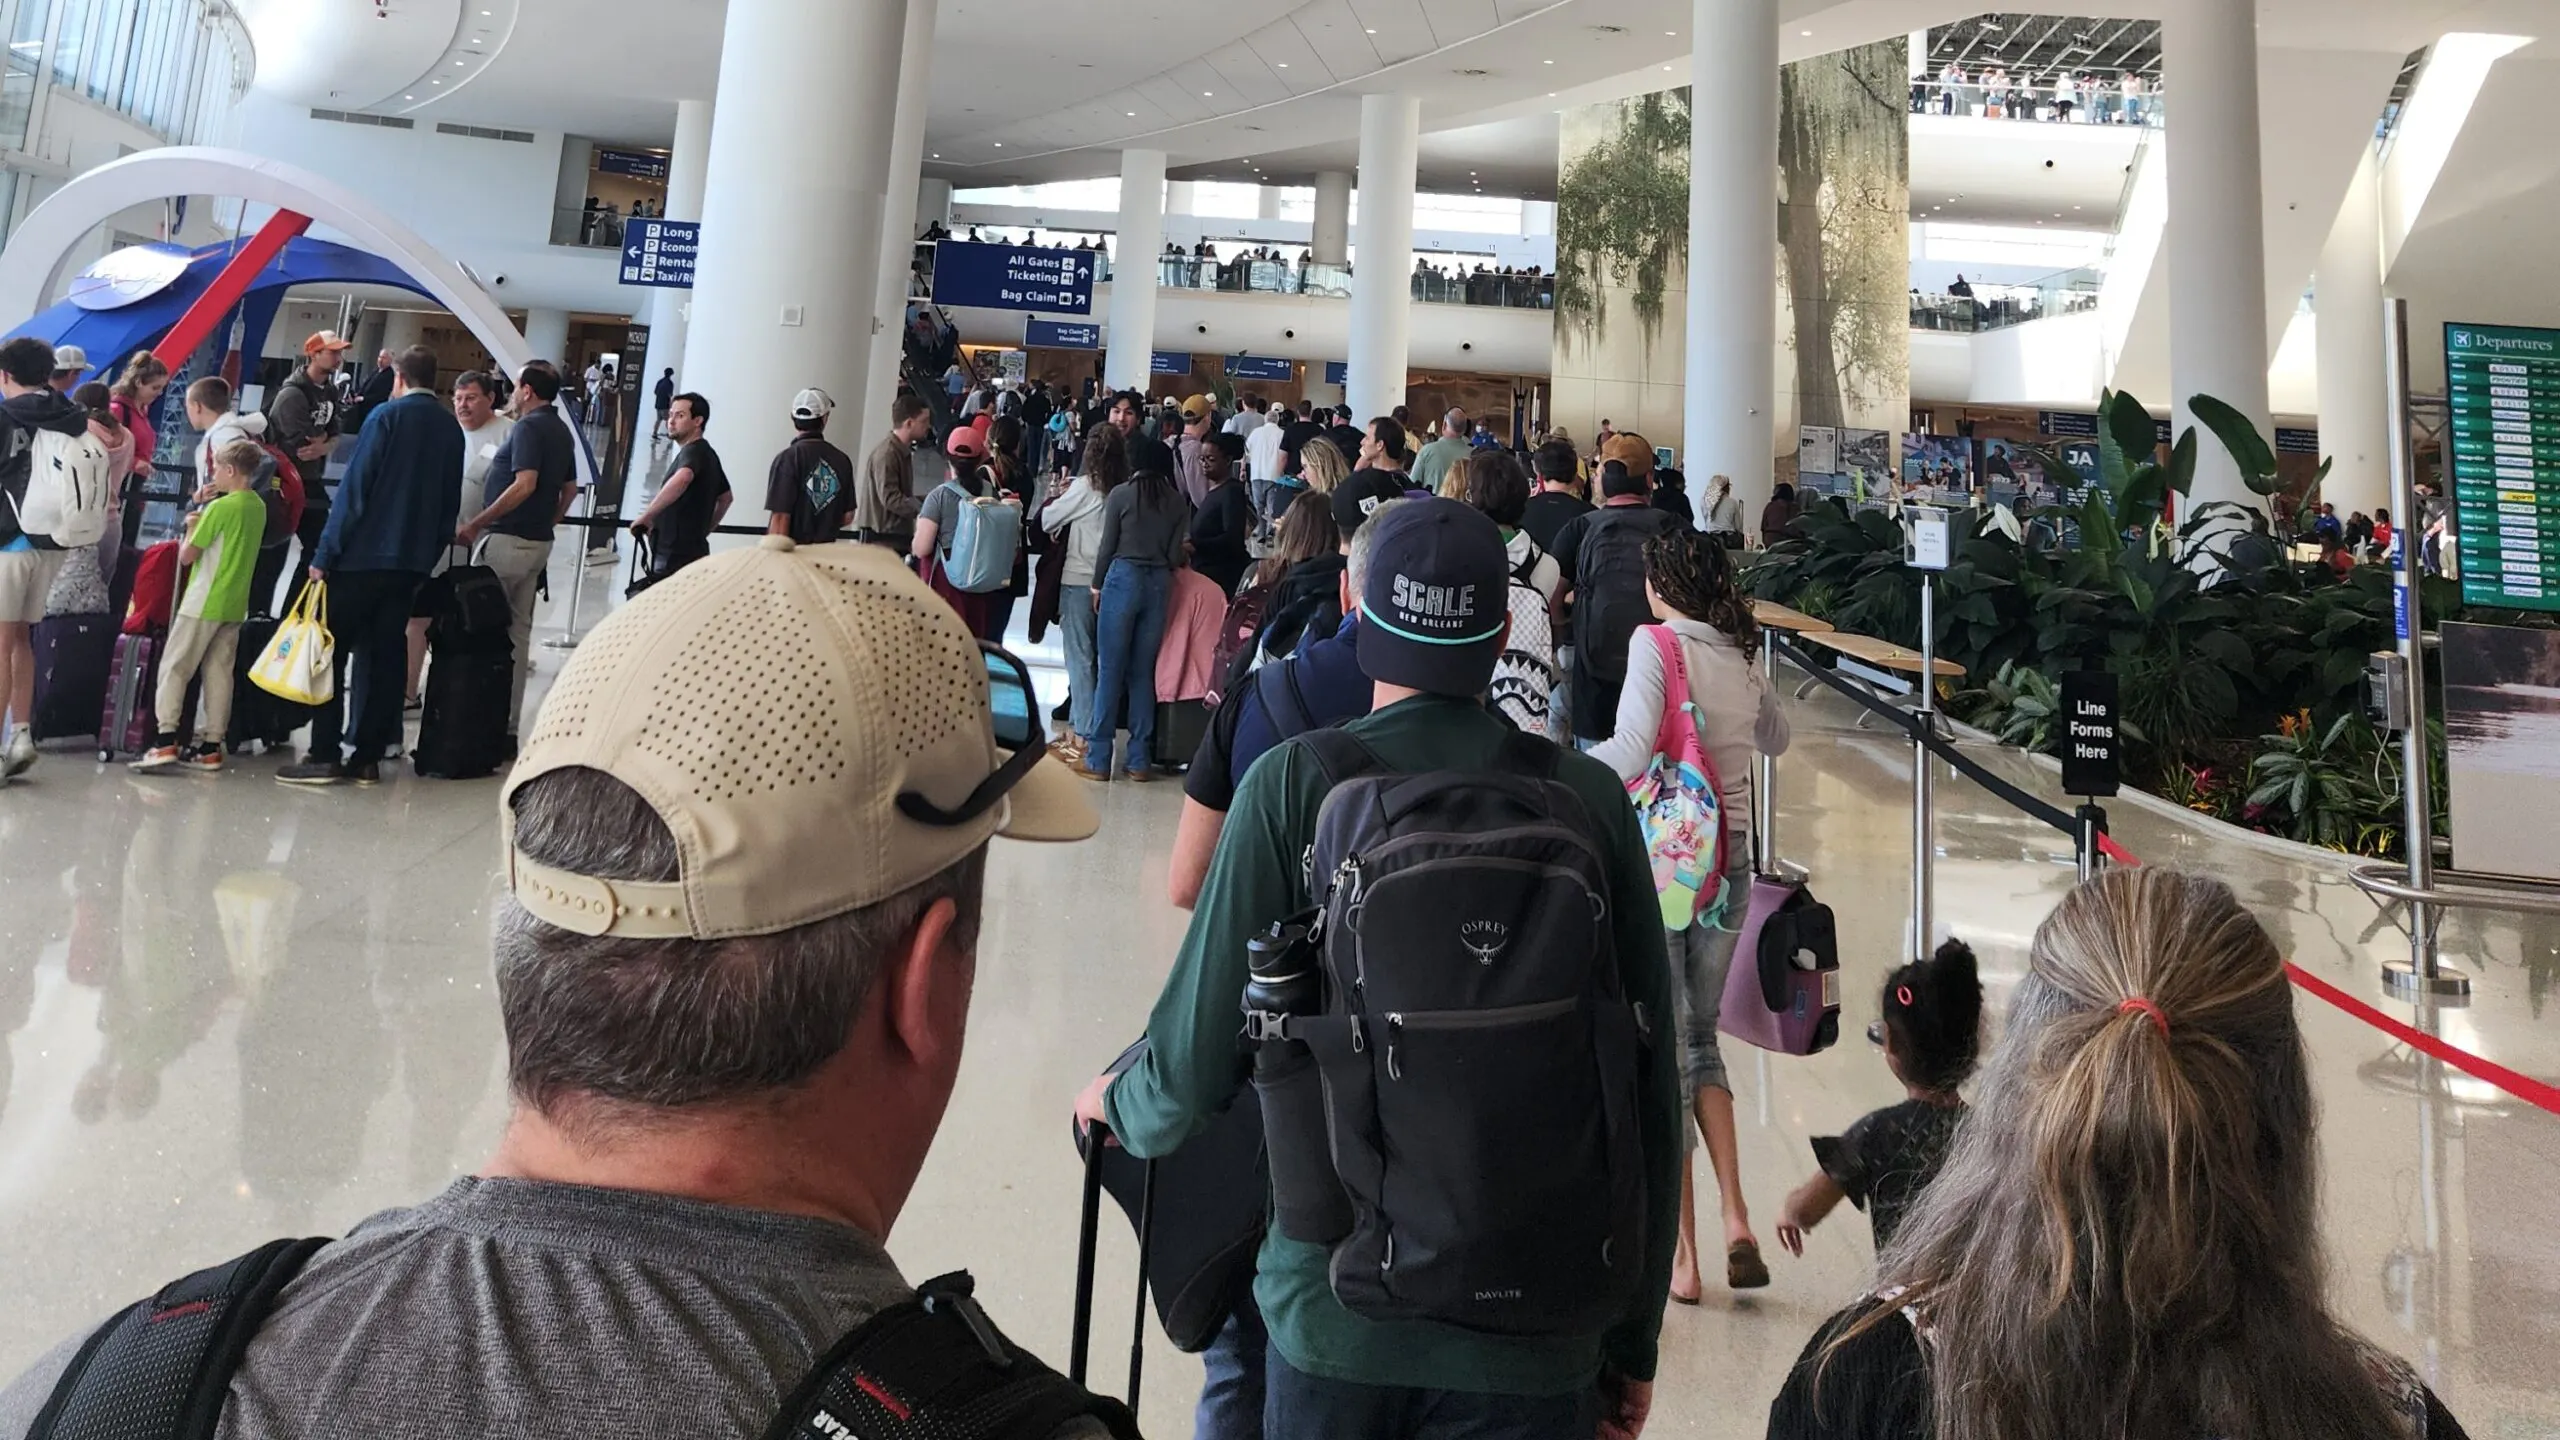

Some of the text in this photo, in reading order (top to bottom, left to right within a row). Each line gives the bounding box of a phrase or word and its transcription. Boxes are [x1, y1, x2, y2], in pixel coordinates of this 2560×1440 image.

[663, 227, 693, 240] Long
[661, 242, 698, 253] Econom
[1008, 255, 1060, 268] All Gates
[656, 271, 694, 283] Taxi/Ri
[1008, 270, 1059, 285] Ticketing
[1001, 289, 1057, 303] Bag Claim
[2475, 334, 2553, 351] Departures
[1392, 573, 1475, 617] SCALE
[1399, 611, 1464, 628] NEW ORLEANS
[2077, 700, 2107, 716] Line
[2070, 721, 2113, 738] Forms
[2075, 743, 2108, 759] Here
[1462, 920, 1508, 936] OSPREY
[1475, 1290, 1521, 1300] DAYLITE
